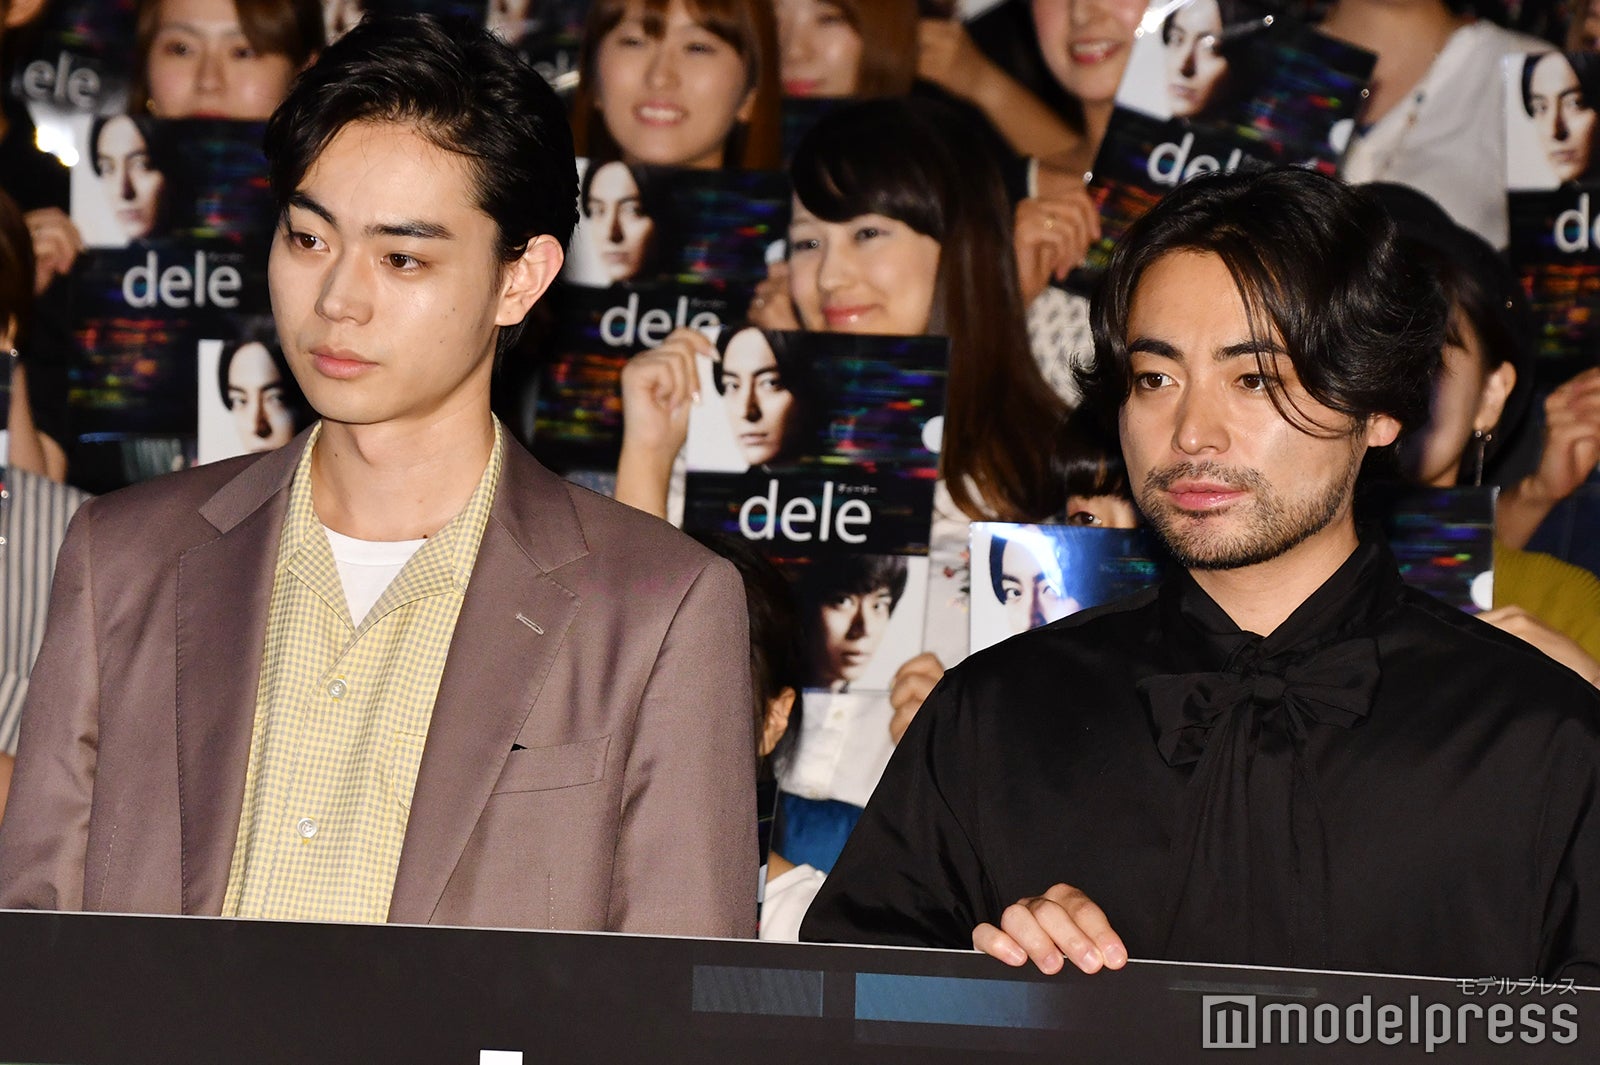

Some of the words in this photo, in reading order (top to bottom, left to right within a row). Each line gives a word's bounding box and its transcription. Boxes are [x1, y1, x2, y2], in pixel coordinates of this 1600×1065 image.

[12, 50, 100, 107] ele
[122, 249, 242, 308] dele
[739, 478, 872, 544] dele
